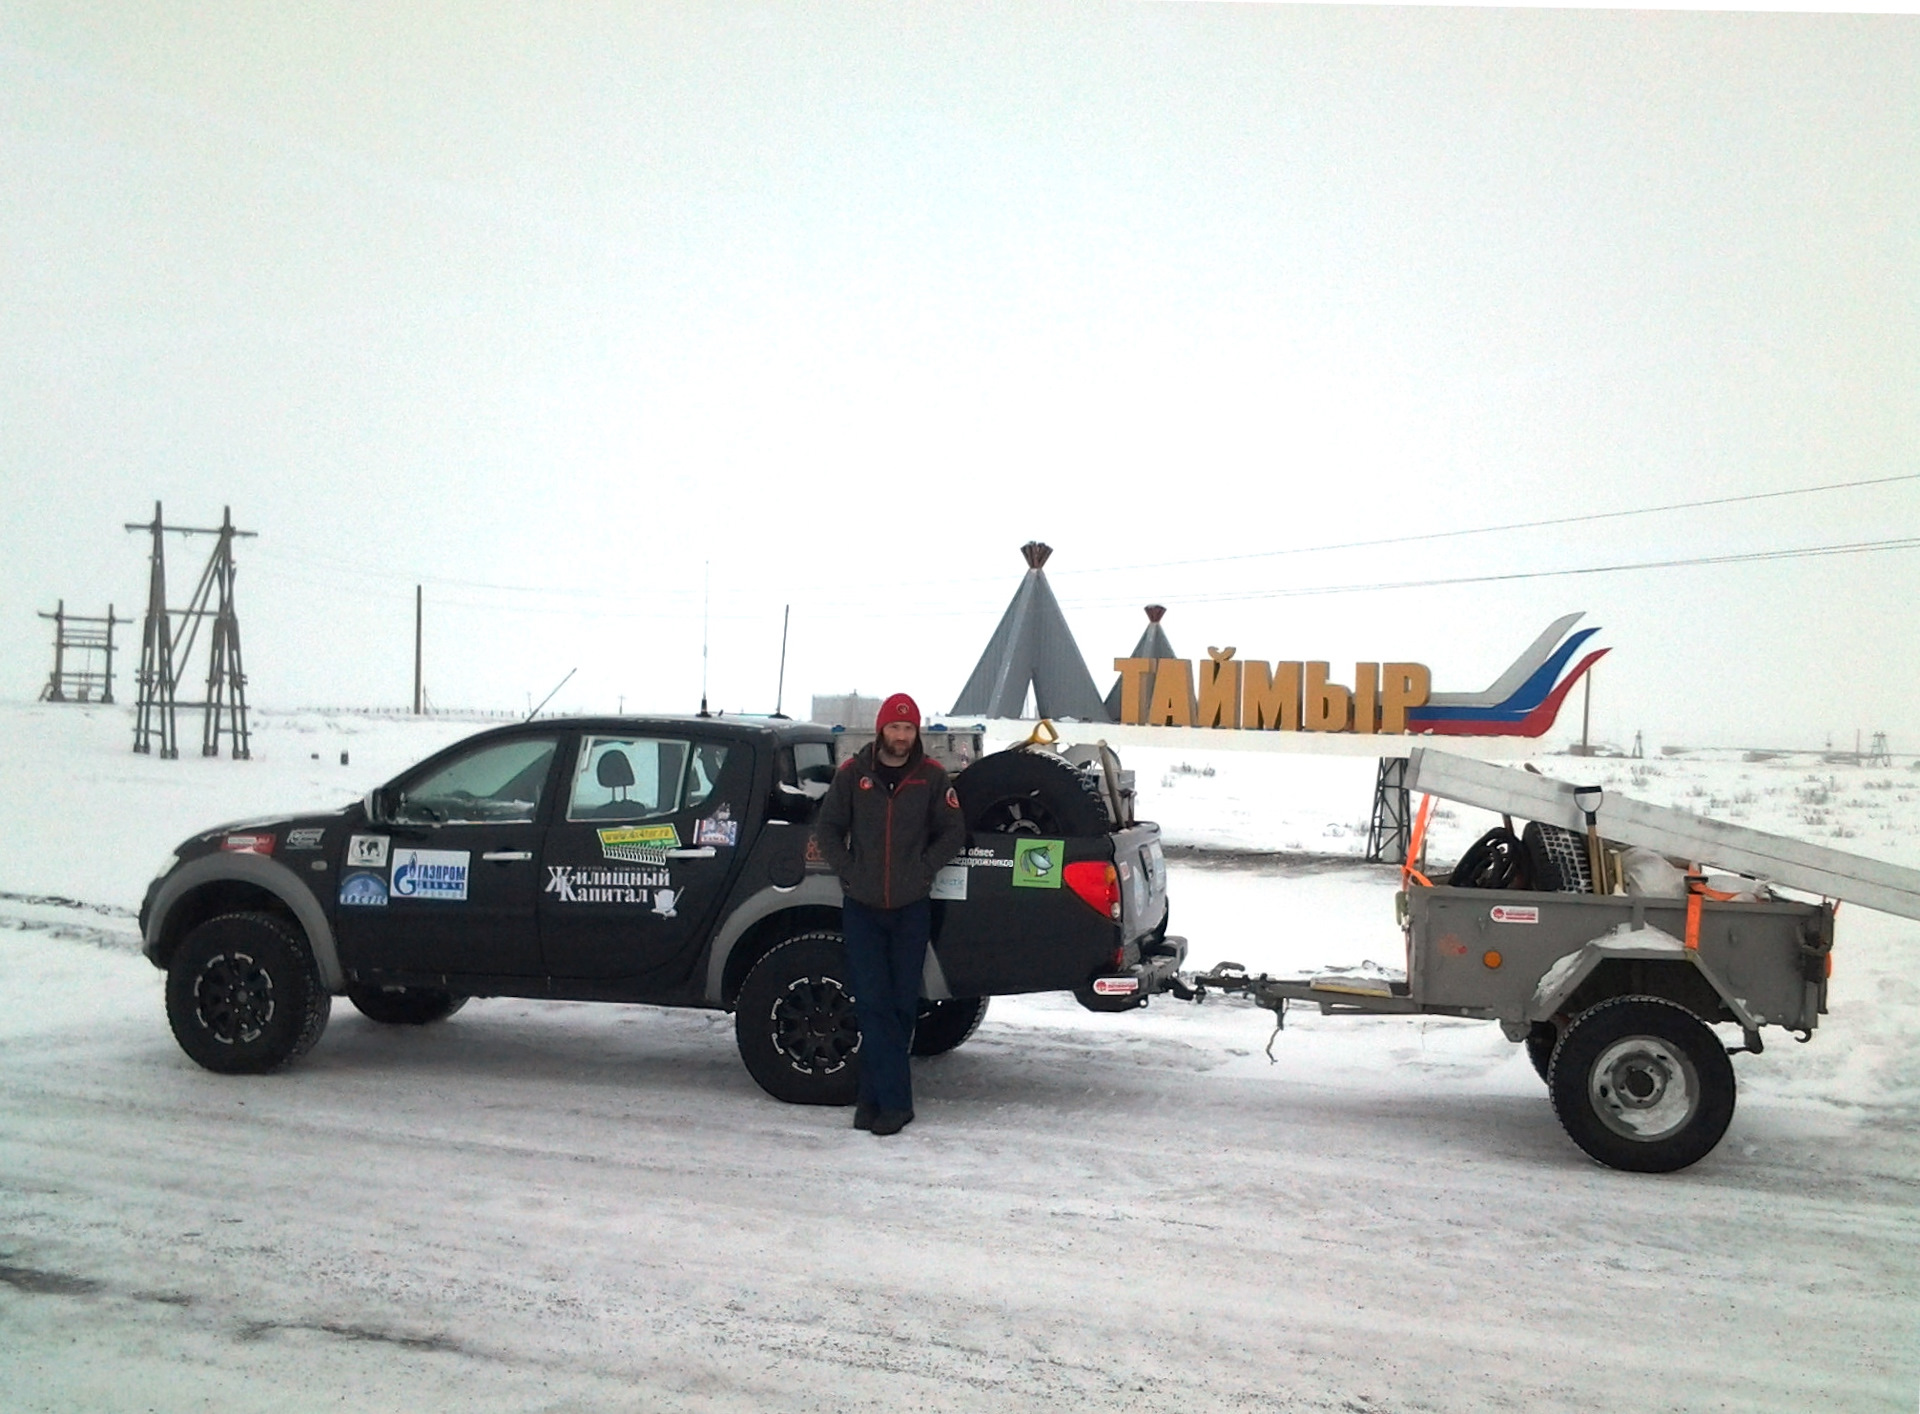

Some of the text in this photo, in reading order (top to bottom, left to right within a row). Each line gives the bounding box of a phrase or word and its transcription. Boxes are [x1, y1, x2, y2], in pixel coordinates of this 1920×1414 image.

[1114, 646, 1432, 735] ТАЙМЫР
[418, 865, 466, 881] ГАЗПРОМ
[545, 866, 670, 892] Жилищный
[560, 876, 648, 902] Капитал
